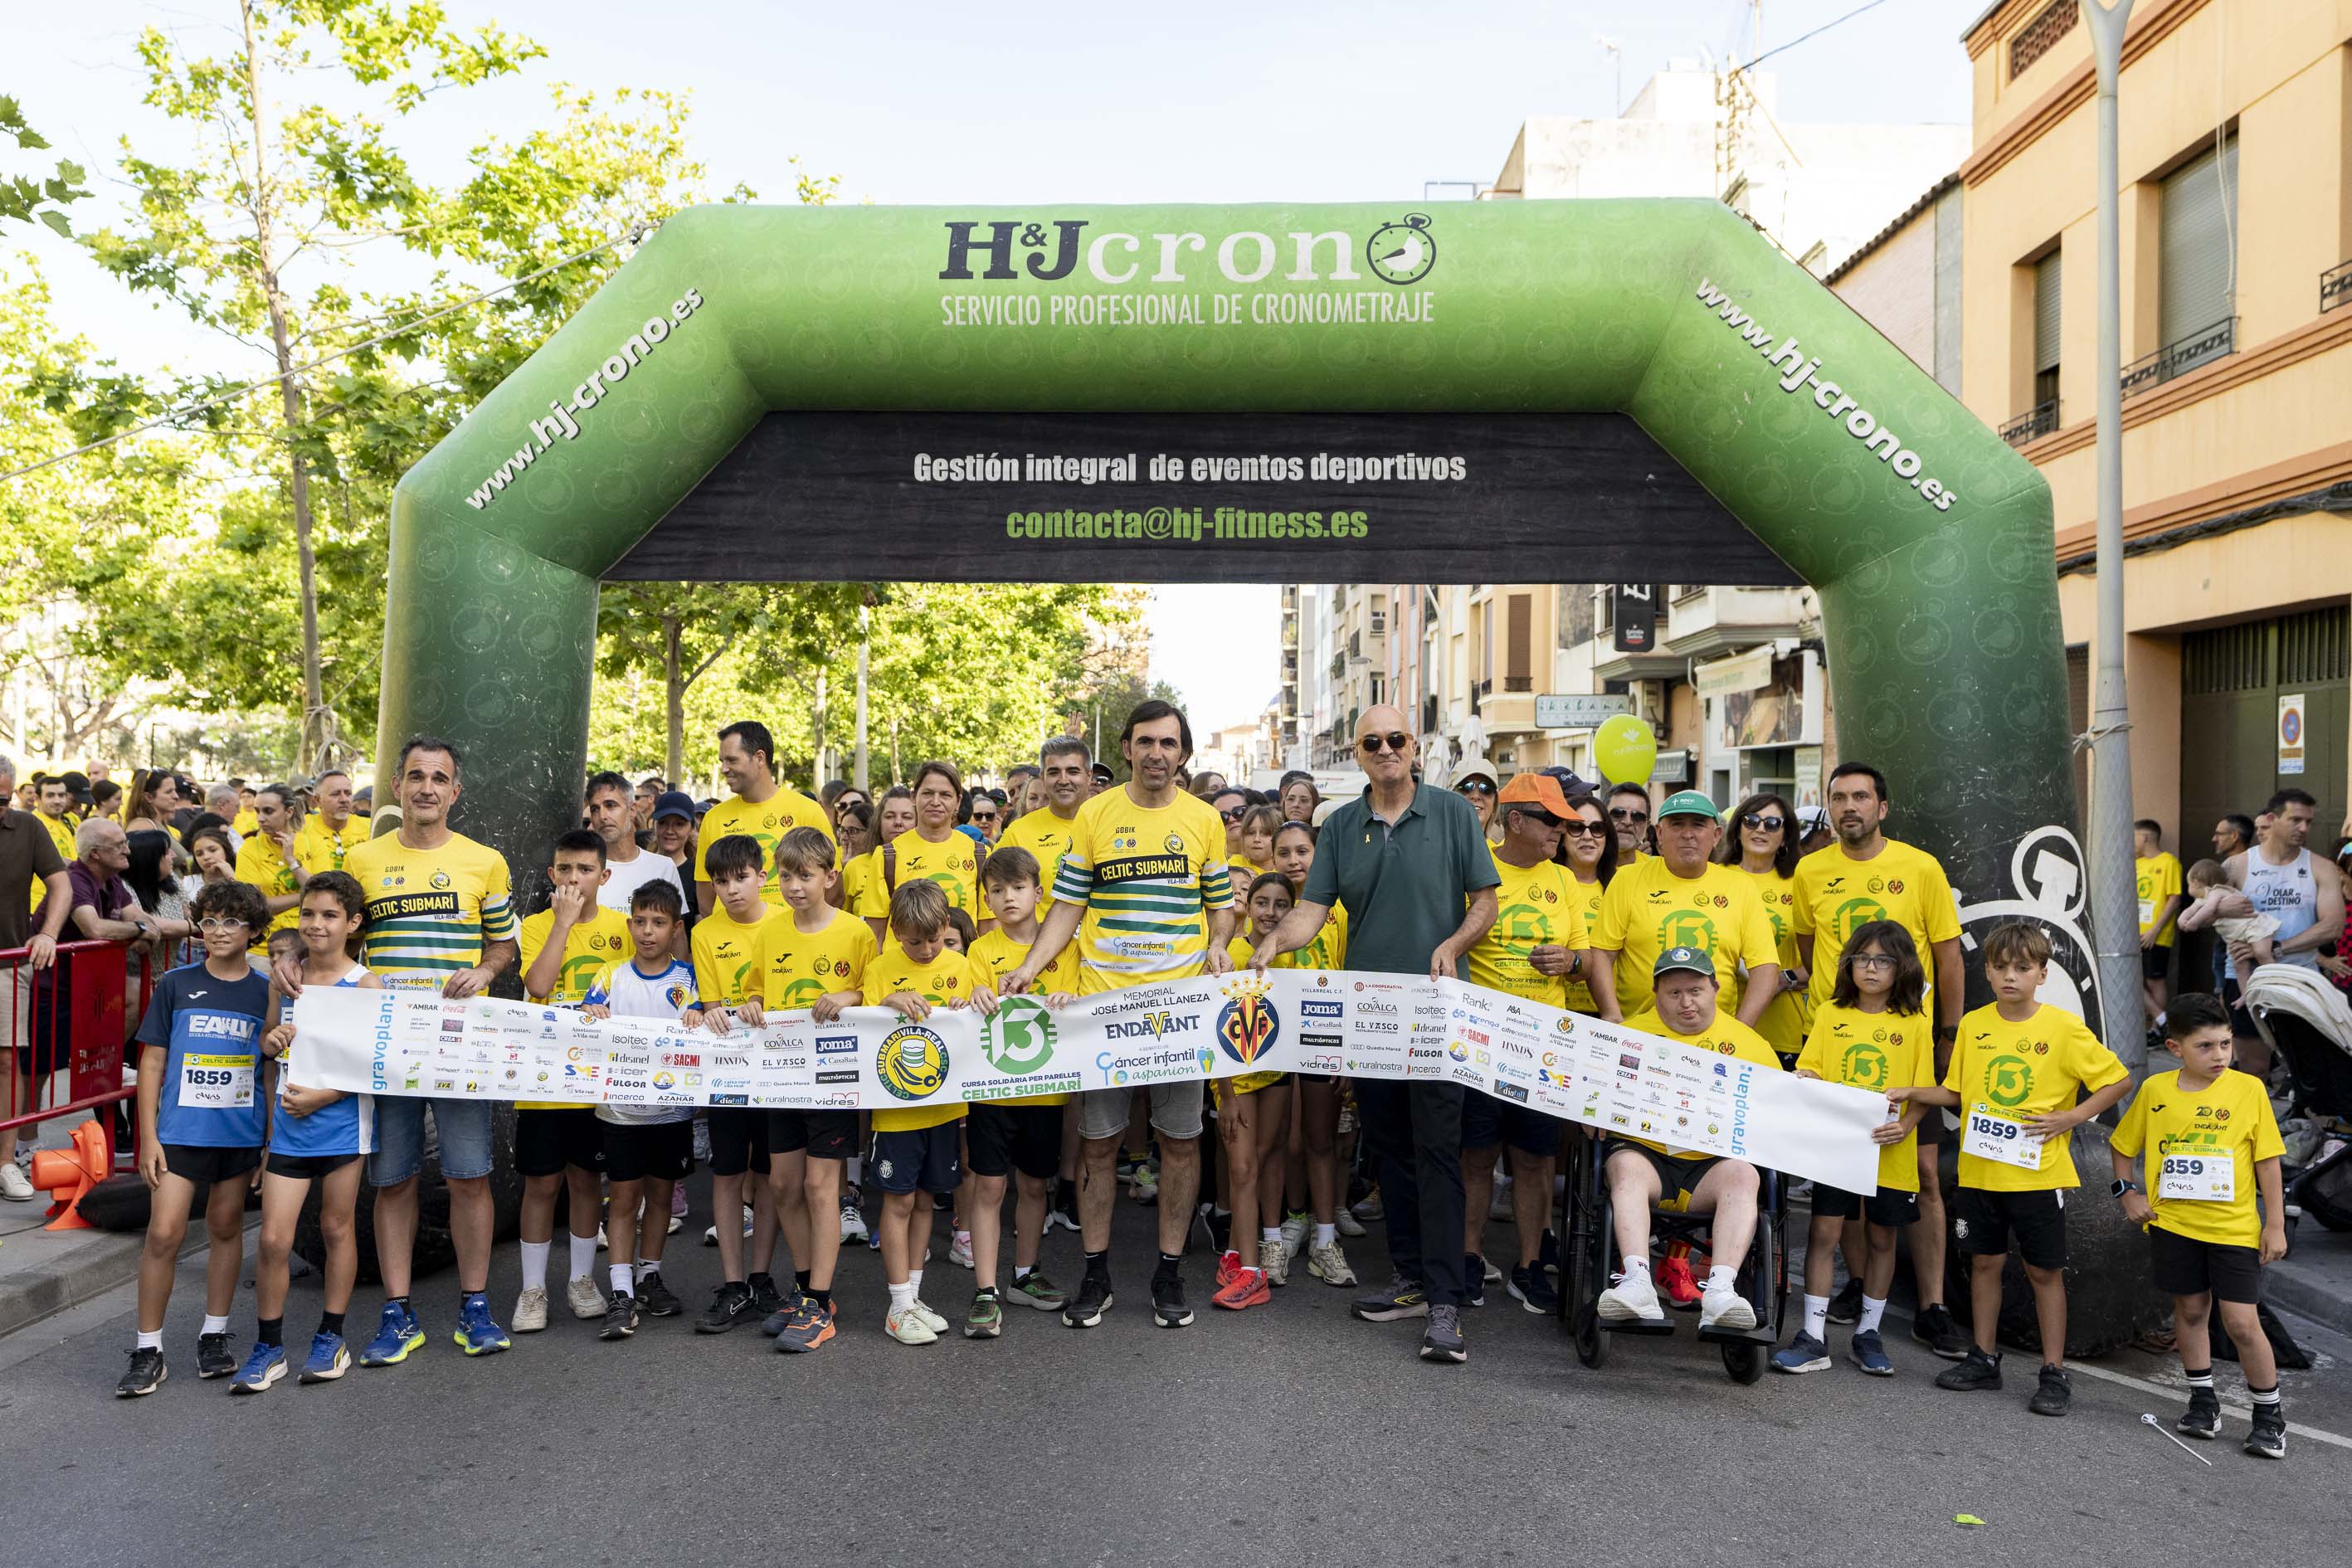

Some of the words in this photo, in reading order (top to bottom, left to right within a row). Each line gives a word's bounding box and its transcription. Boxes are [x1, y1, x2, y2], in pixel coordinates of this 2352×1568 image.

[940, 294, 1041, 326] SERVICIO
[1051, 294, 1205, 325] PROFESIONAL
[1215, 293, 1244, 324] DE
[1253, 291, 1434, 324] CRONOMETRAJE
[465, 287, 704, 509] www.hj-crono.es
[1696, 277, 1957, 511] www.hj-crono.es
[913, 453, 1019, 483] Gestión
[1025, 453, 1137, 485] integral
[1150, 454, 1184, 482] de
[1191, 455, 1303, 482] eventos
[1311, 453, 1467, 484] deportivos
[1006, 506, 1369, 542] contacta@hj-fitness.es
[1102, 862, 1133, 881] CELTIC
[1136, 858, 1185, 876] SUBMARÍ
[369, 900, 398, 918] CELTIC
[401, 894, 454, 913] SUBMARÍ
[1143, 941, 1166, 950] infantil
[1123, 986, 1175, 1001] MEMORIAL
[1091, 1003, 1118, 1015] JOSÉ
[1120, 998, 1161, 1012] MANUEL
[1164, 992, 1210, 1006] LLANEZA
[1357, 1002, 1398, 1011] COVALCA
[1415, 1006, 1446, 1015] Isoltec
[1507, 1005, 1521, 1015] A&A
[1105, 1011, 1200, 1042] ENDAVANT
[612, 1035, 648, 1045] Isoltec
[764, 1039, 803, 1048] COVALCA
[901, 1027, 946, 1053] VILA-REAL
[1468, 1029, 1489, 1046] SACMI
[1594, 1032, 1618, 1044] AMBAR
[674, 1054, 700, 1067] SACMI
[1153, 1048, 1195, 1067] infantil
[1300, 1060, 1337, 1069] vidres
[1360, 1062, 1402, 1071] ruralnostra
[186, 1069, 232, 1085] 1859
[988, 1077, 1028, 1085] SOLIDÀRIA
[1044, 1072, 1081, 1080] PARELLES
[1132, 1067, 1197, 1082] aspanion
[1454, 1069, 1483, 1083] AZAHAR
[962, 1087, 1010, 1100] CELTIC
[1015, 1078, 1081, 1096] SUBMARÍ
[815, 1094, 855, 1105] vidres
[1973, 1116, 2017, 1139] 1859
